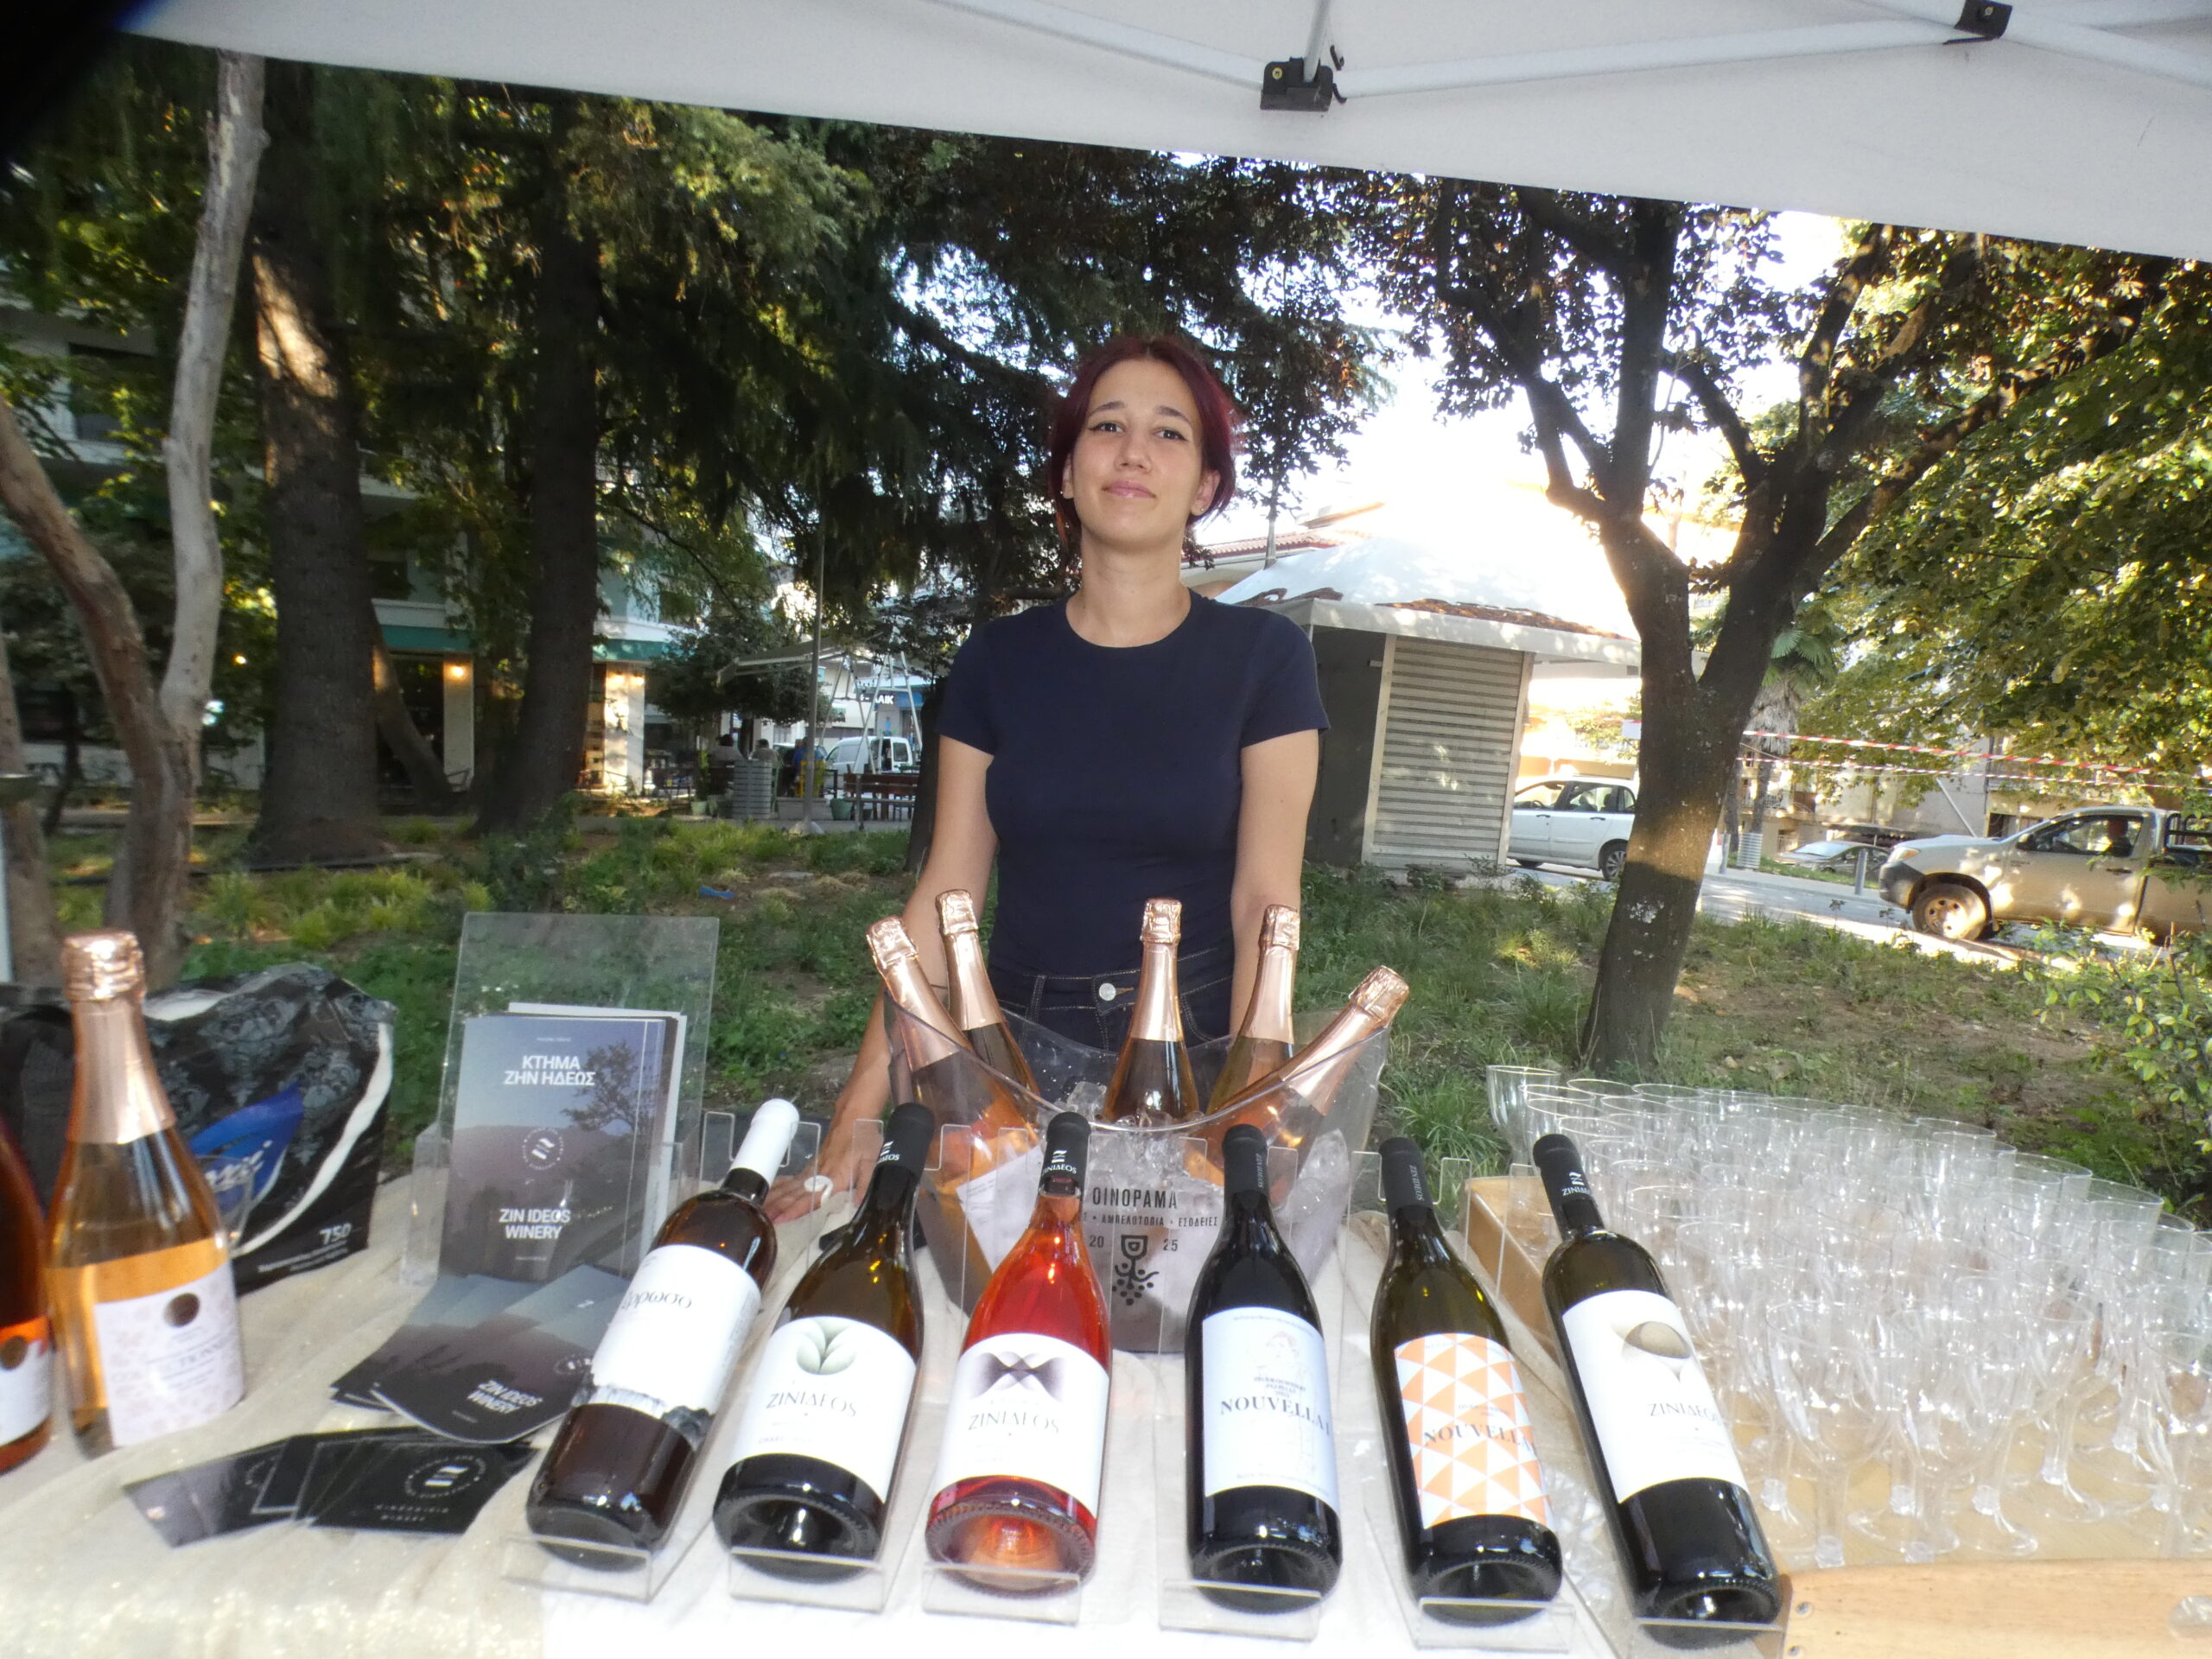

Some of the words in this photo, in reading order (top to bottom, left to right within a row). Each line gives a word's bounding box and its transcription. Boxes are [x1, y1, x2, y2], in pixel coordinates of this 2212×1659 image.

[522, 1055, 581, 1071] ΚΤΗΜΑ
[504, 1071, 538, 1085] ΖΗΝ
[542, 1071, 596, 1086] ΗΔΕΩΣ
[1092, 1186, 1178, 1210] ΟΙΝΟΡΑΜΑ
[499, 1209, 525, 1223] ZIN
[527, 1209, 571, 1224] IDEOS
[505, 1225, 563, 1239] WINERY
[1089, 1235, 1104, 1249] 20
[1163, 1238, 1179, 1252] 25
